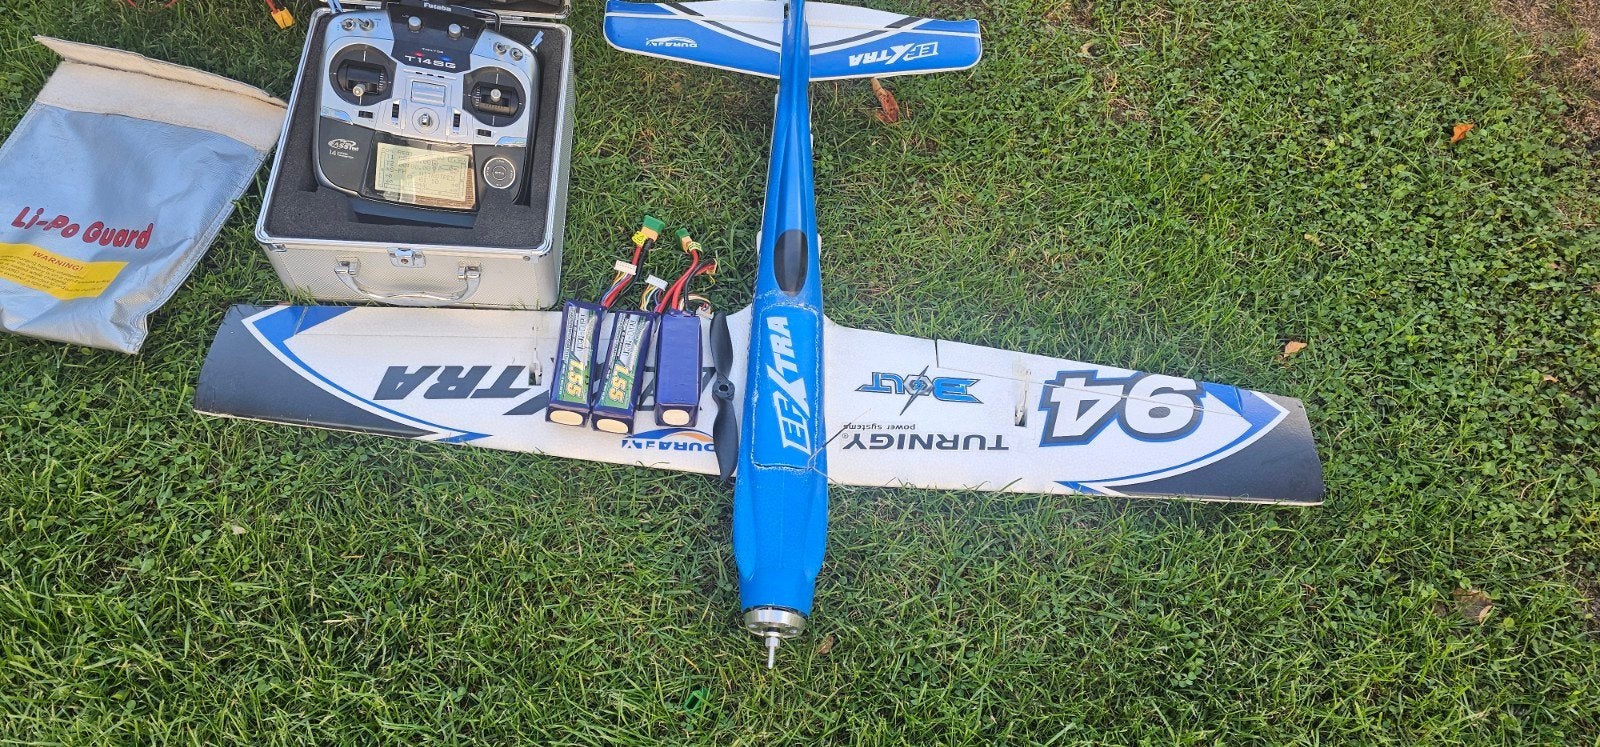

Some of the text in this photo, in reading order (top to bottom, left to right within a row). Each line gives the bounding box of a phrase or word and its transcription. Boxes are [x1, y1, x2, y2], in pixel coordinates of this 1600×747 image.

[424, 2, 452, 12] Futaba
[11, 206, 154, 250] Li-Po Guard
[33, 251, 83, 271] WARNING!
[1038, 369, 1206, 448] 94
[843, 423, 916, 431] power systems
